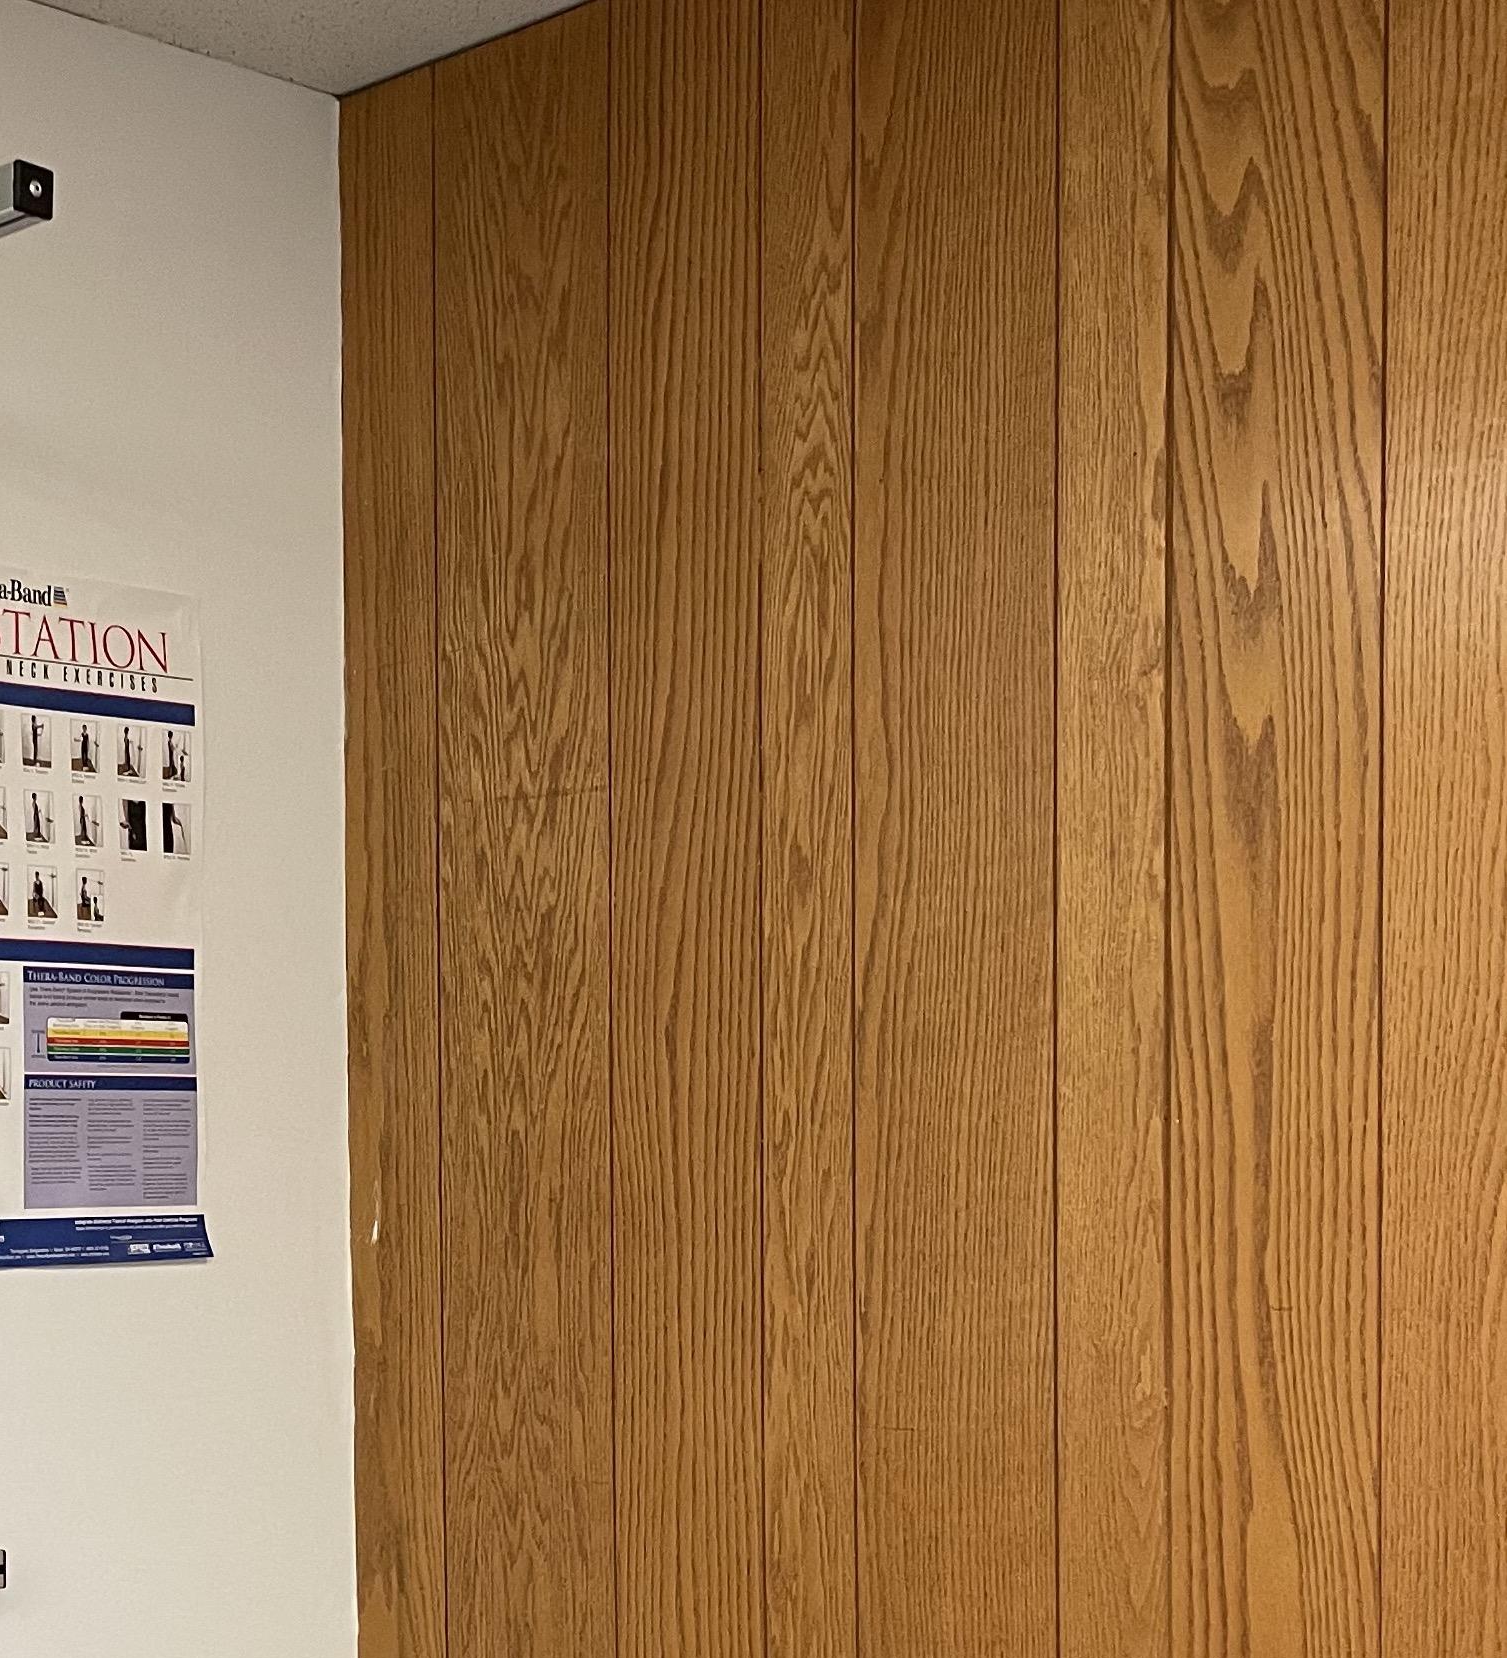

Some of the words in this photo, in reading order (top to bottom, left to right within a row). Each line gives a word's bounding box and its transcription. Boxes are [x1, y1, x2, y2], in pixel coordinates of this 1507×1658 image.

[5, 658, 50, 680] NECK
[63, 665, 158, 694] EXERCISES
[83, 973, 113, 985] COLOR
